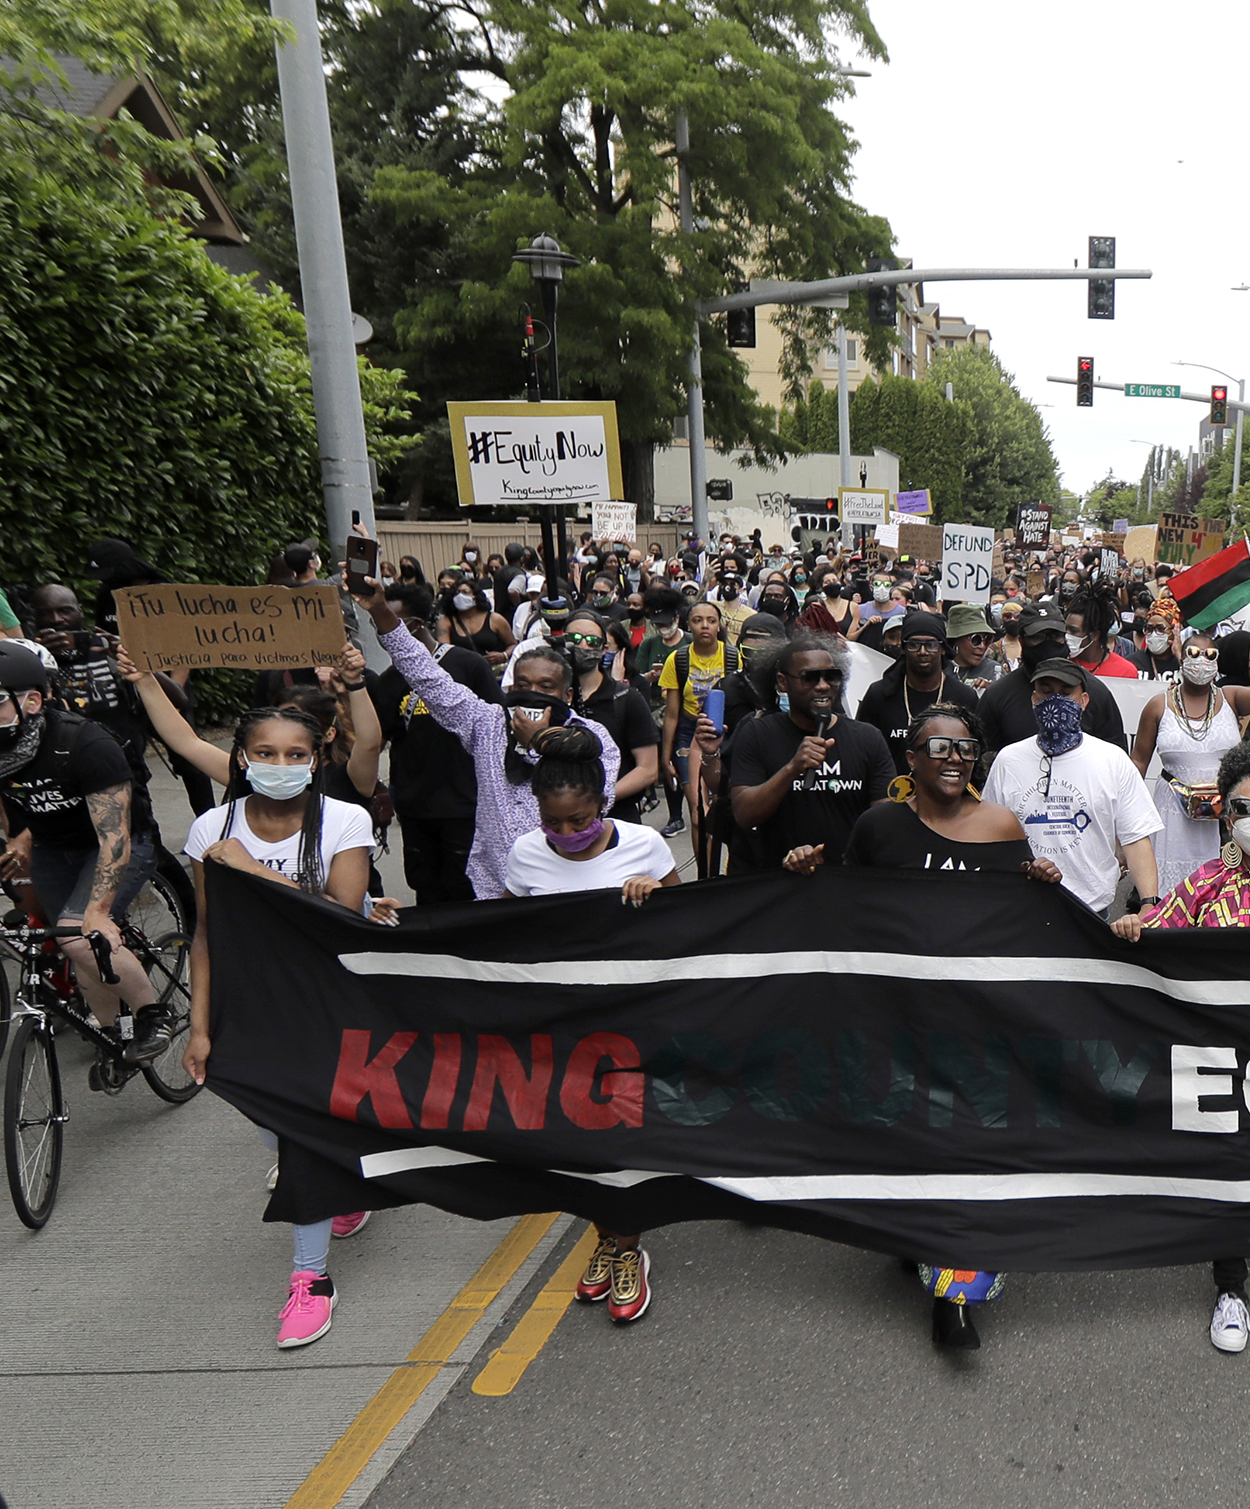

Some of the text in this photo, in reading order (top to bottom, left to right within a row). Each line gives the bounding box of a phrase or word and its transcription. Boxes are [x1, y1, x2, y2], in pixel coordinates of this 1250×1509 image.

[1129, 385, 1176, 397] E Olive St
[468, 431, 603, 476] #EquityNow
[1021, 509, 1048, 521] #STAND
[1163, 513, 1199, 529] THIS
[1019, 520, 1049, 532] AGAINST
[944, 533, 993, 552] DEFUND
[1023, 531, 1043, 544] HATE
[1158, 527, 1184, 543] NEW
[1157, 542, 1196, 565] JULY
[947, 562, 990, 591] SPD
[175, 590, 236, 616] lucha
[250, 595, 282, 618] es
[194, 621, 276, 647] lucha!
[219, 650, 248, 667] para
[29, 791, 64, 804] IVES
[1060, 779, 1087, 809] MATTER
[30, 797, 82, 813] MATTE
